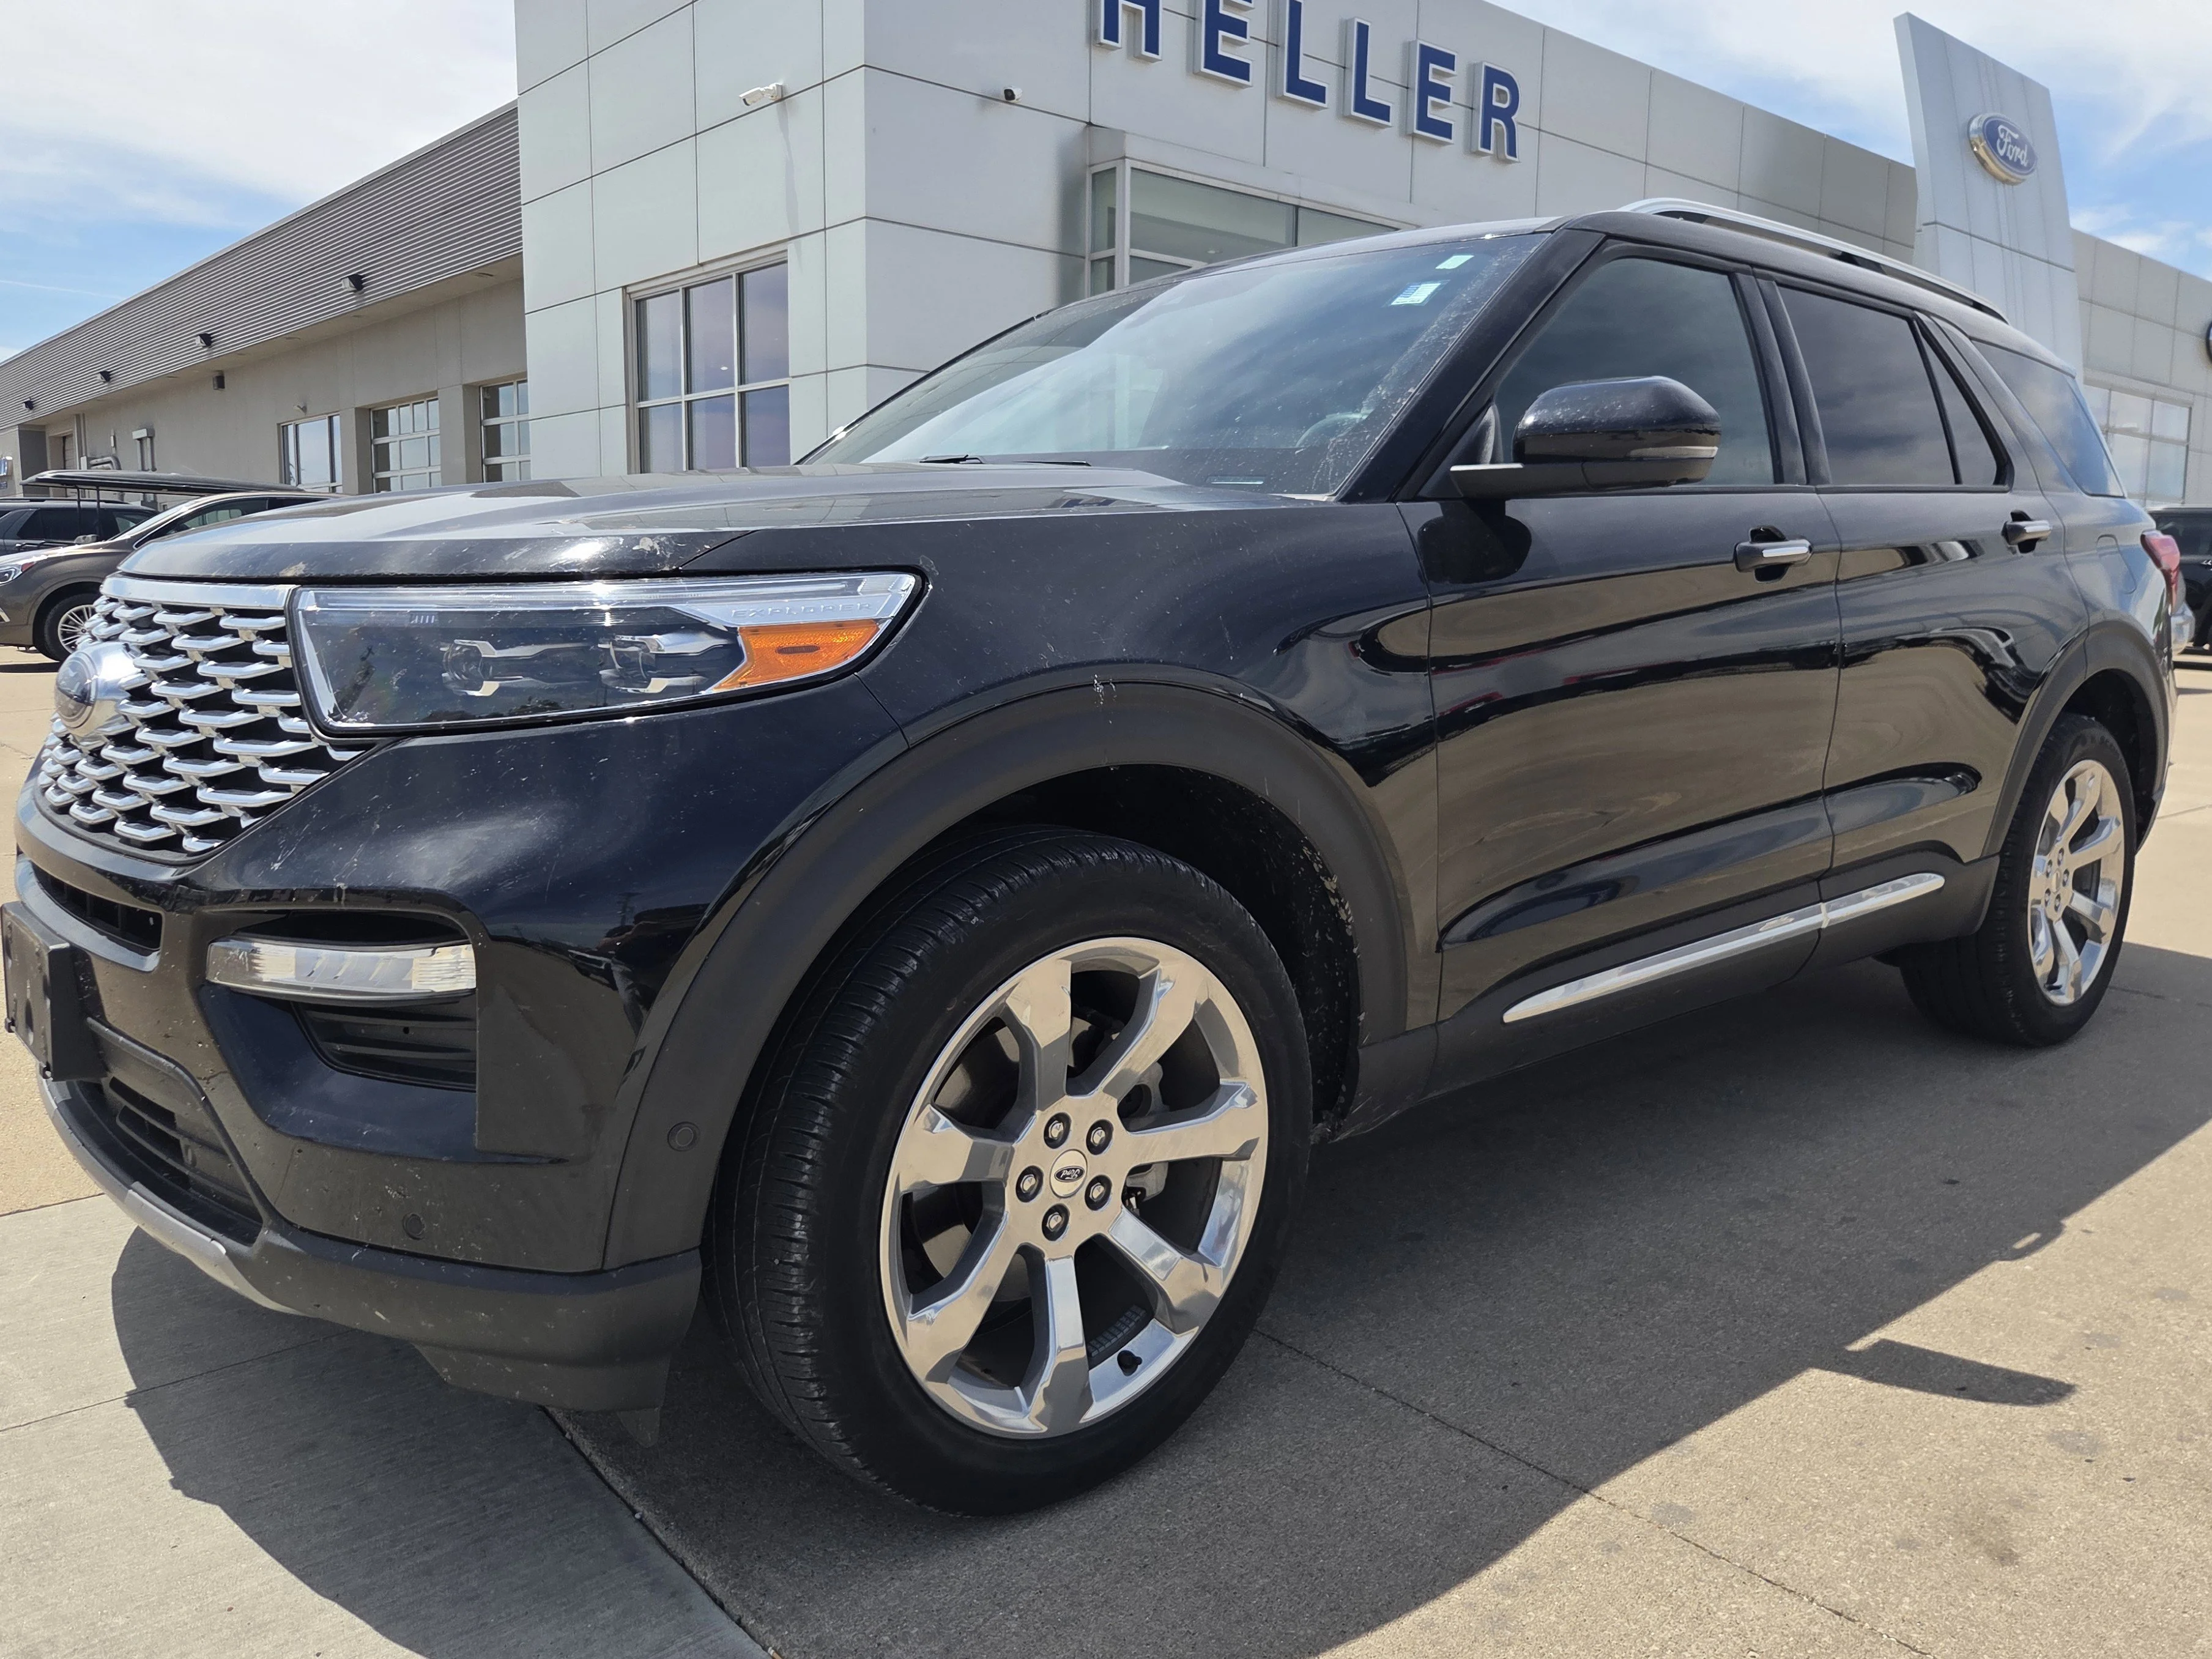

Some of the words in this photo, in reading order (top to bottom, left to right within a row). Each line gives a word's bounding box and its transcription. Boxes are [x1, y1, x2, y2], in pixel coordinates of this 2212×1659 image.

[1997, 124, 2028, 167] Ford
[732, 602, 872, 618] EXPLORER
[1060, 1168, 1080, 1180] Ford
